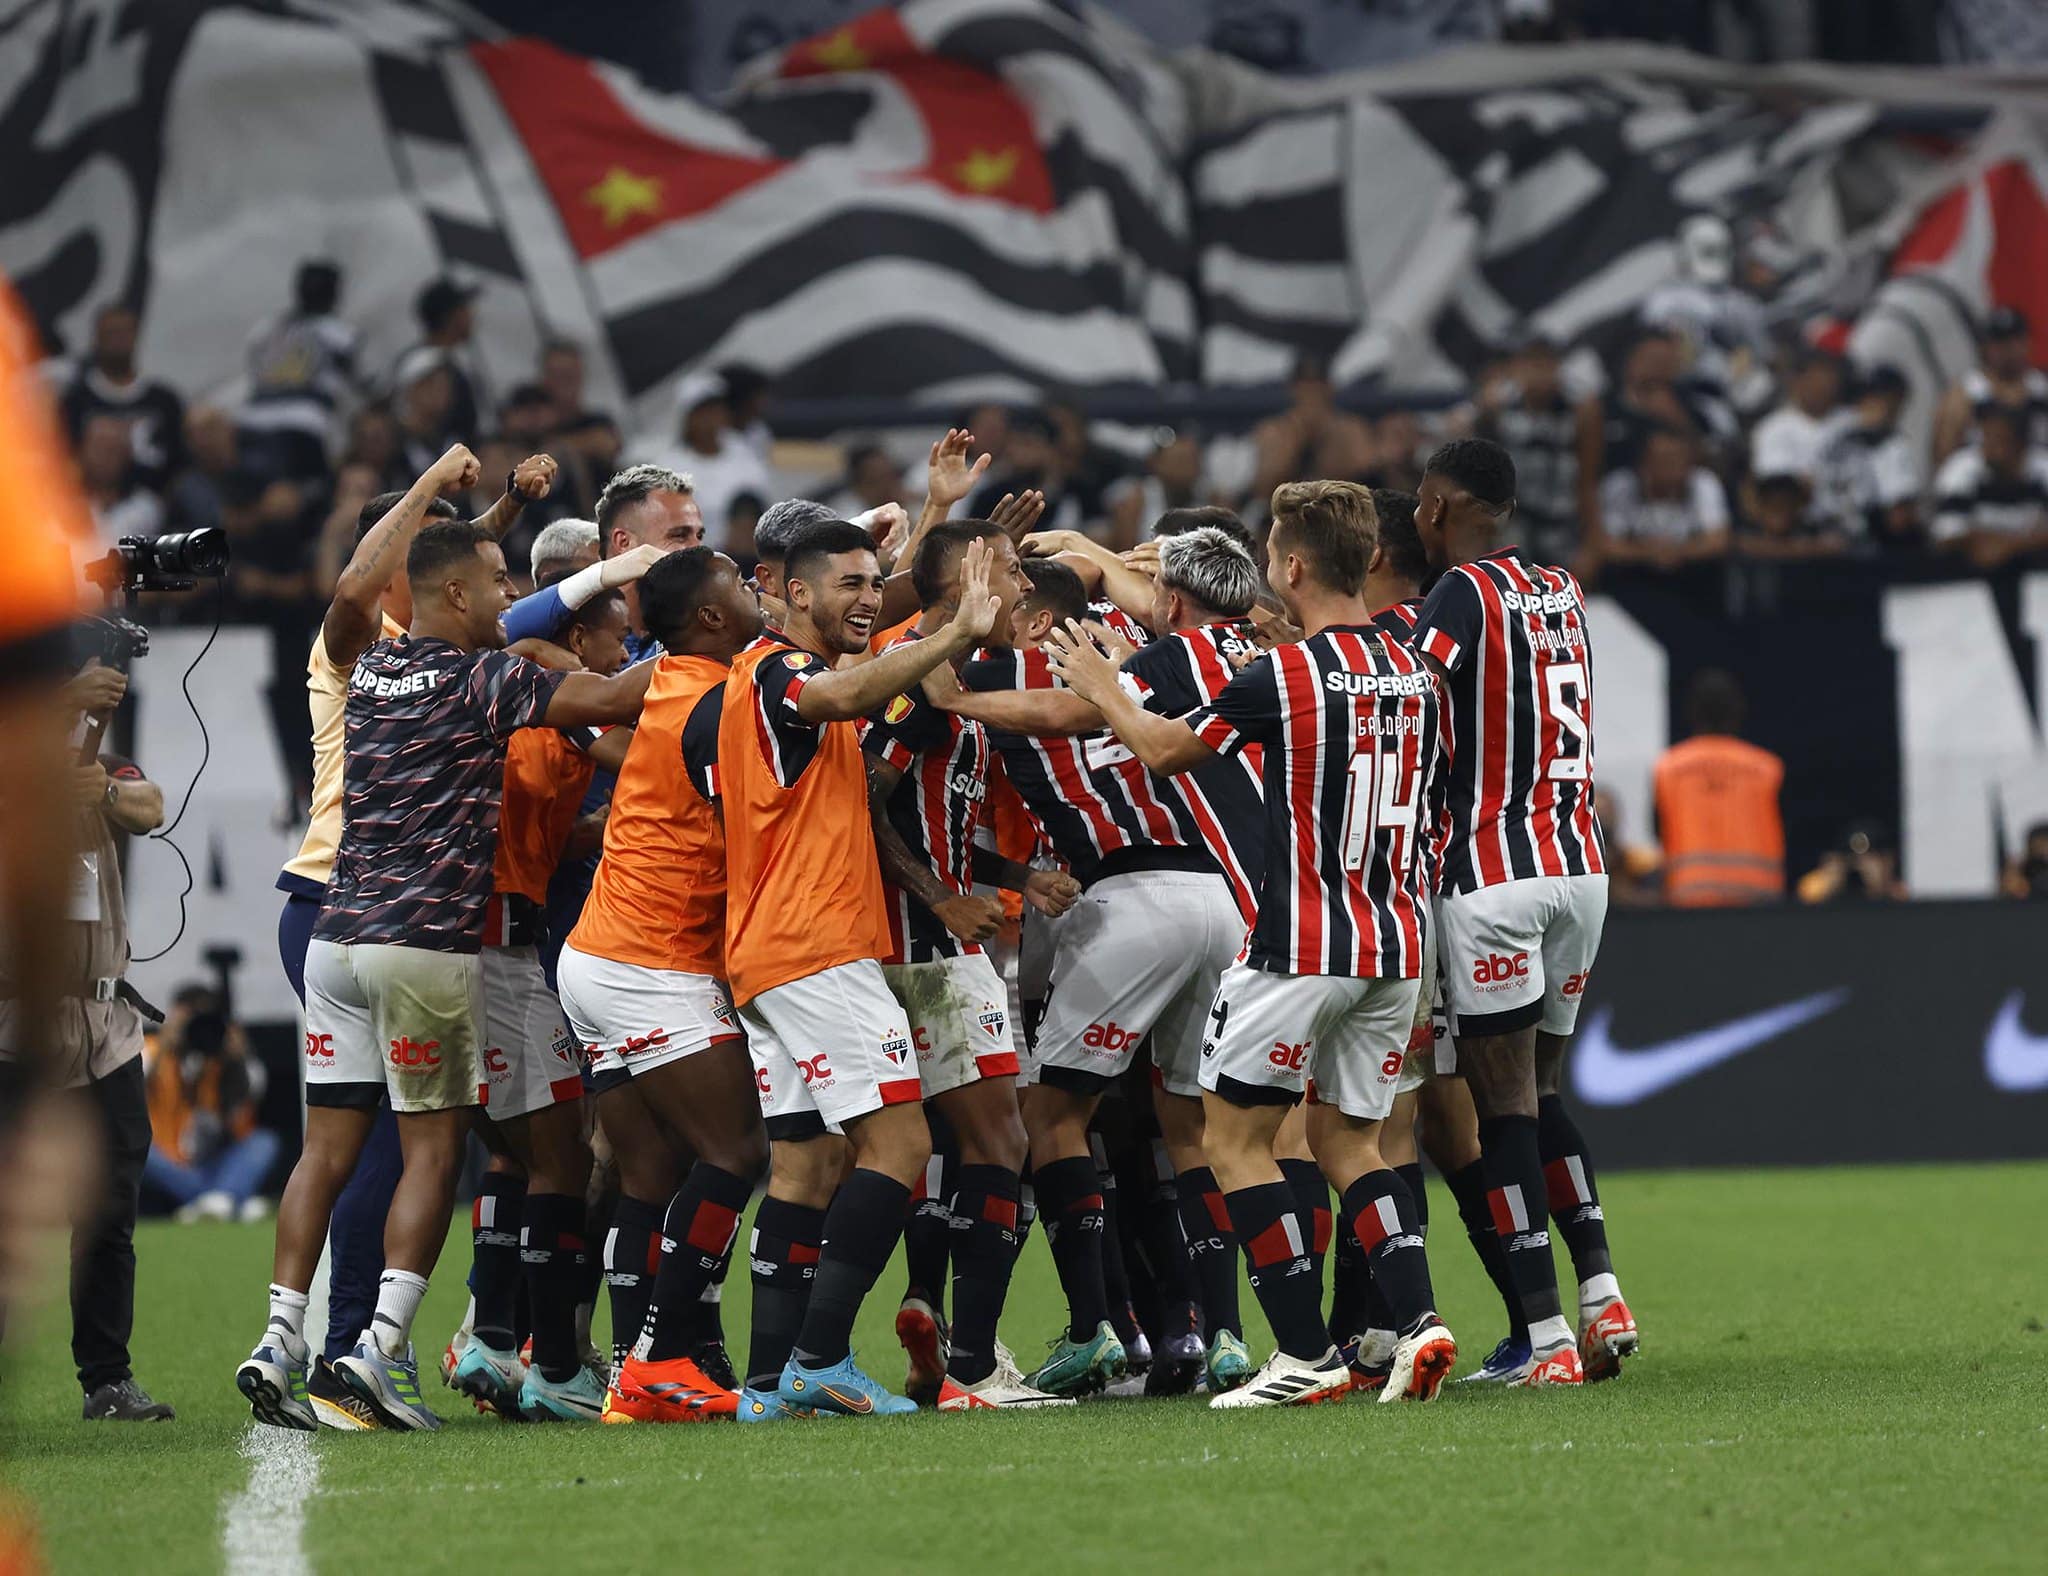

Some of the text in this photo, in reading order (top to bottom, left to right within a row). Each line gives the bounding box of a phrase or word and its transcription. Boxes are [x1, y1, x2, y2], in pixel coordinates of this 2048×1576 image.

[351, 662, 440, 697] SUPERBET
[1326, 670, 1430, 696] SUPERBET
[1357, 715, 1420, 737] GALOPPO
[1545, 663, 1588, 779] 5
[1347, 752, 1422, 870] 14
[1473, 952, 1529, 984] abc
[390, 1036, 441, 1066] abc
[882, 1040, 907, 1053] SPFC
[1188, 1237, 1225, 1260] PFC
